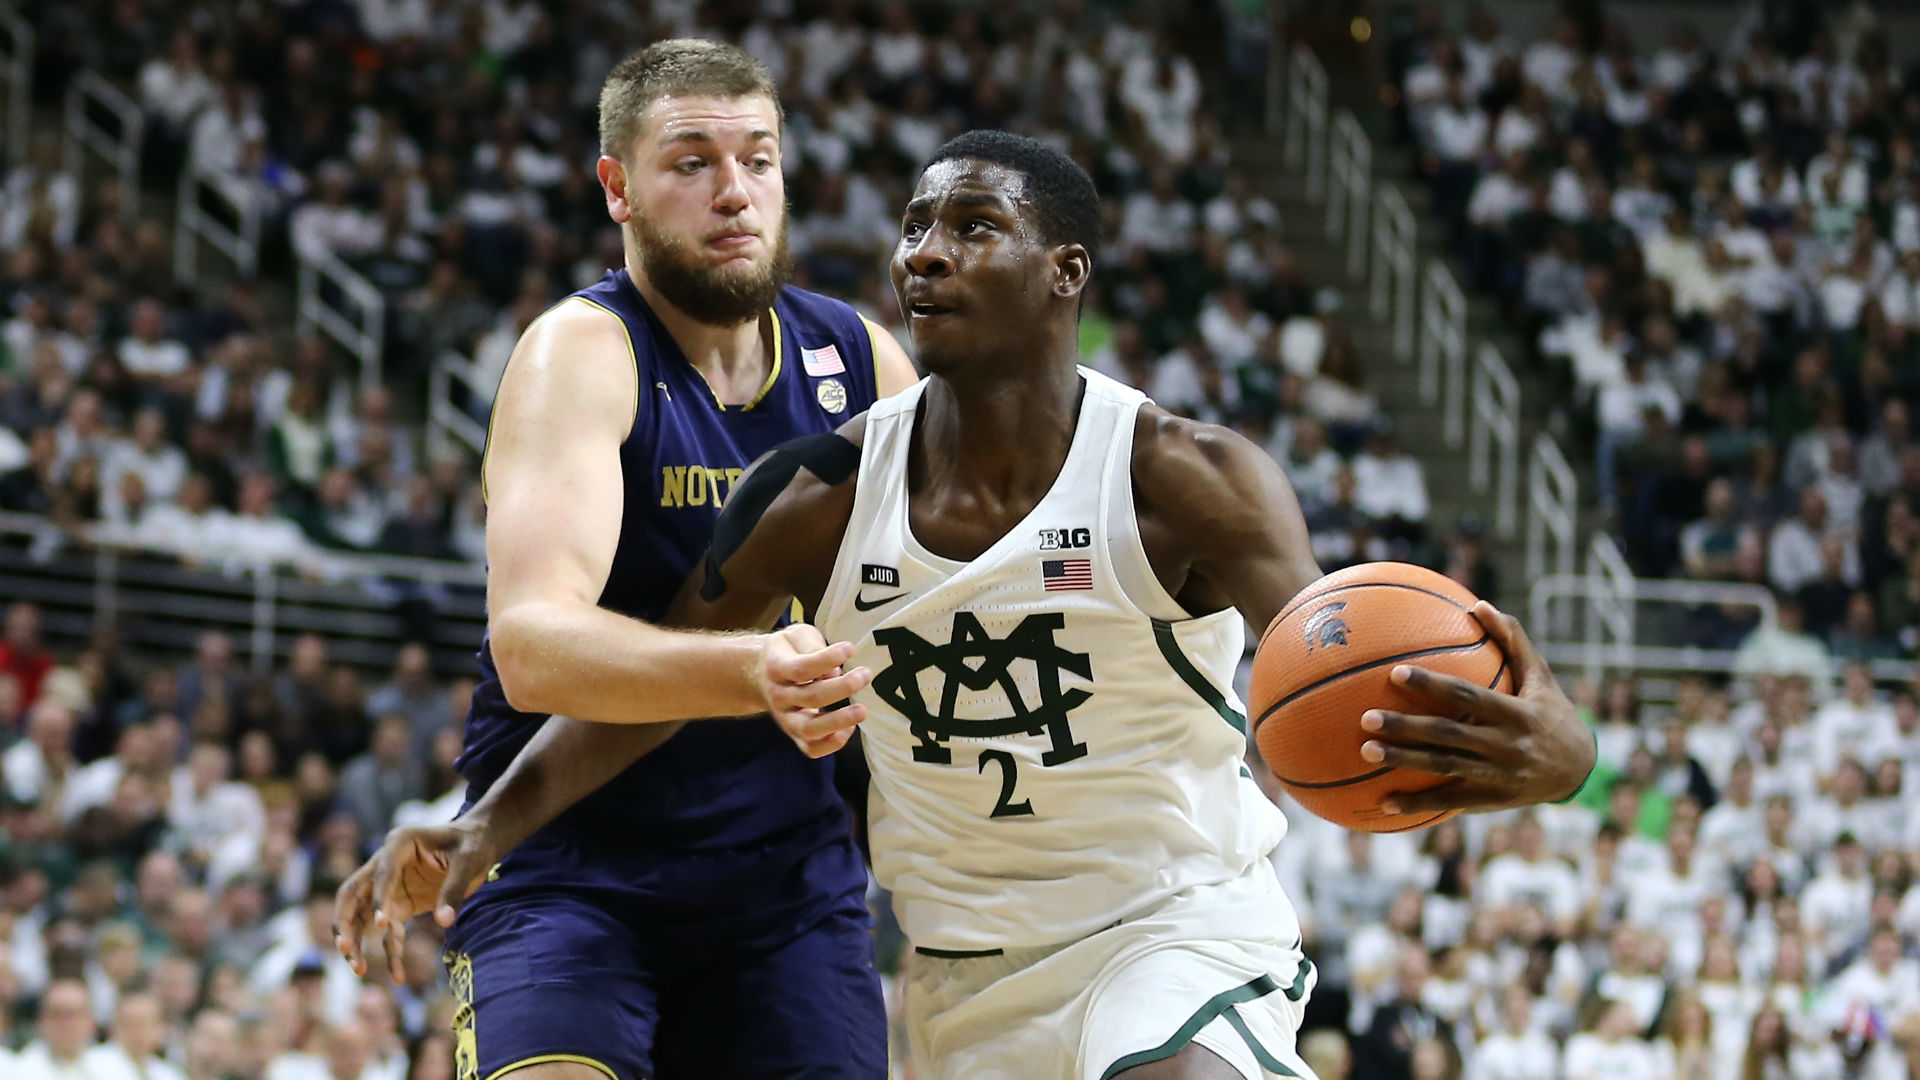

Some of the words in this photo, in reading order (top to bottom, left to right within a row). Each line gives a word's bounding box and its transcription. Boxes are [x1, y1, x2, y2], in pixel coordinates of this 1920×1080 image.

[821, 388, 845, 401] ACC
[870, 568, 894, 583] JUD
[978, 749, 1035, 819] 2
